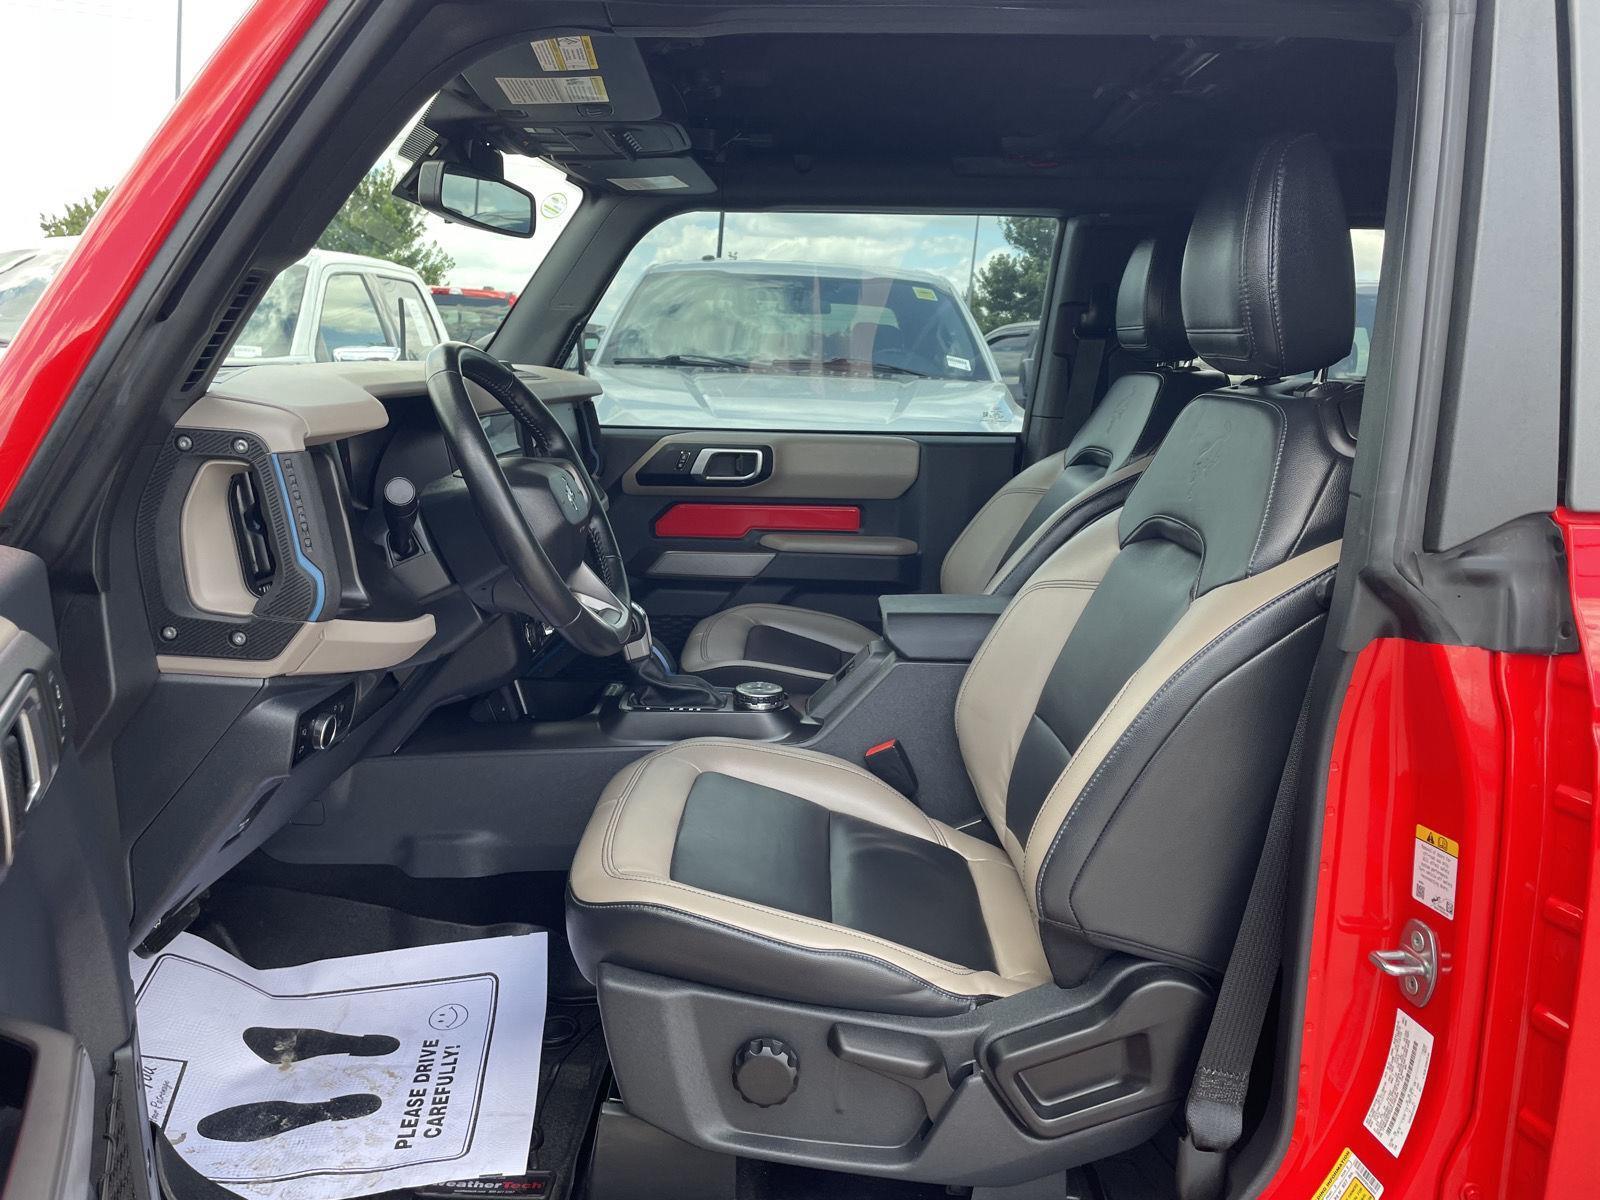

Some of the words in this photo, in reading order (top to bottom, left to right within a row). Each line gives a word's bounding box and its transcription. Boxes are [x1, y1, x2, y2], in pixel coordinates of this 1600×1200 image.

[143, 1066, 157, 1089] ou
[394, 1088, 427, 1149] PLEASE
[413, 1039, 440, 1083] DRIVE
[423, 1045, 461, 1138] CAREFULLY!
[1326, 1151, 1350, 1187] INFORMATION
